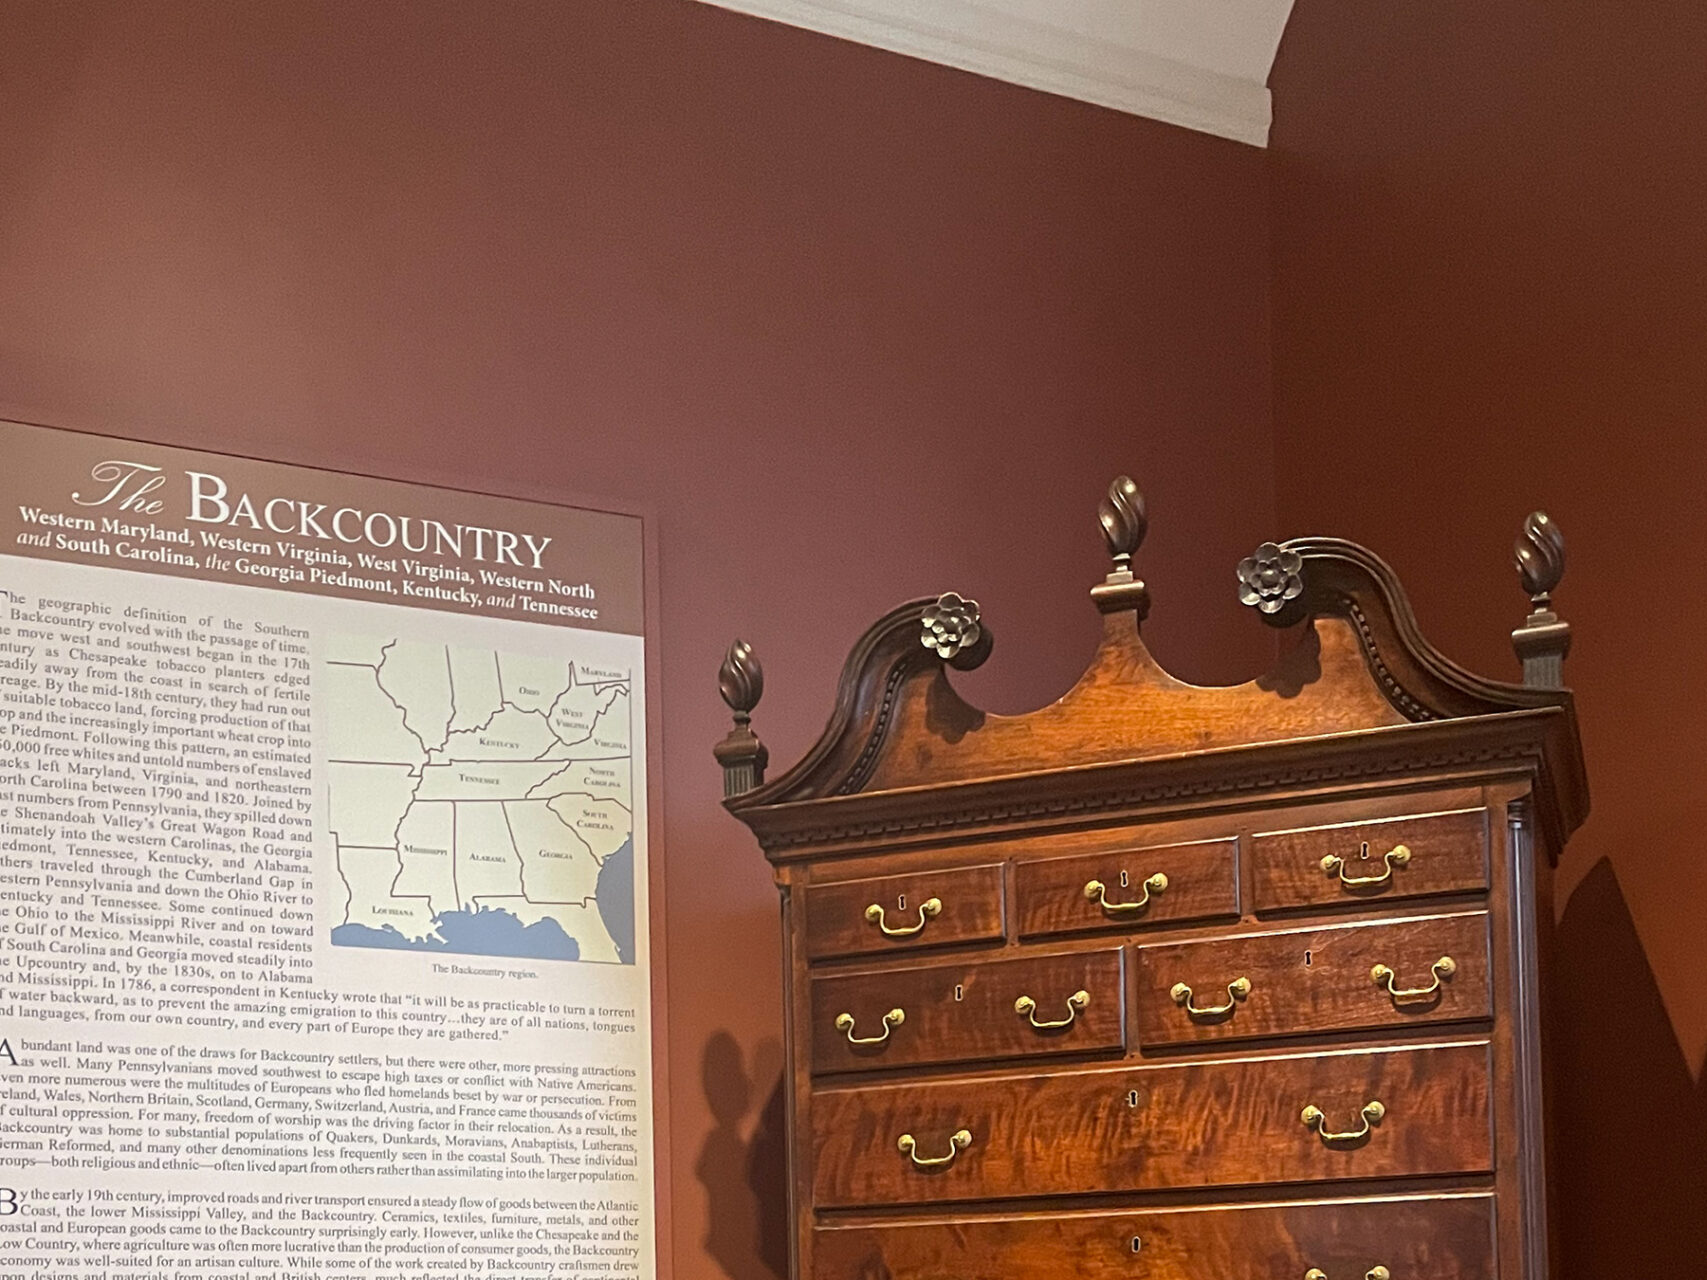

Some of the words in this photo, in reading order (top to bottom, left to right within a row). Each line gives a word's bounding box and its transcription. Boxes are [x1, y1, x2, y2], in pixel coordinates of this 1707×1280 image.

[72, 459, 166, 515] The
[186, 471, 551, 569] BACKCOUNTRY
[19, 505, 95, 530] Western
[100, 517, 194, 546] Maryland,
[200, 530, 270, 555] Western
[277, 541, 352, 568] Virginia,
[357, 552, 397, 572] West
[402, 558, 474, 584] Virginia,
[479, 569, 543, 592] Western
[548, 578, 594, 599] North
[16, 530, 50, 547] and
[55, 533, 110, 555] South
[115, 541, 199, 569] Carolina,
[205, 553, 230, 571] the
[234, 557, 304, 583] Georgia
[310, 567, 397, 595] Piedmont,
[402, 579, 482, 607] Kentucky,
[486, 593, 515, 608] and
[518, 595, 597, 619] Tennessee
[10, 607, 94, 632] Backcountry
[98, 620, 150, 635] evolved
[153, 626, 182, 639] with
[186, 629, 205, 642] the
[209, 634, 258, 650] passage
[261, 638, 276, 651] of
[278, 640, 309, 654] time.
[38, 598, 111, 614] geographic
[123, 605, 186, 624] definition
[198, 615, 213, 627] of
[223, 618, 242, 630] the
[254, 621, 309, 638] Southern
[45, 648, 59, 657] as
[68, 647, 146, 667] Chesapeake
[156, 658, 206, 673] tobacco
[215, 664, 265, 680] planters
[273, 671, 309, 687] edged
[30, 774, 87, 791] Carolina
[91, 779, 145, 796] between
[152, 785, 182, 799] 1790
[186, 790, 209, 802] and
[215, 791, 248, 805] 1820.
[252, 794, 293, 809] Joined
[296, 798, 311, 813] by
[14, 805, 95, 824] Shenandoah
[102, 813, 154, 831] Valley’s
[160, 818, 196, 833] Great
[202, 822, 245, 838] Wagon
[252, 826, 284, 840] Road
[290, 831, 312, 842] and
[14, 921, 47, 935] Gulf
[50, 924, 65, 937] of
[70, 925, 123, 940] Mexico.
[129, 929, 204, 947] Meanwhile,
[208, 936, 252, 948] coastal
[257, 938, 312, 952] residents
[432, 964, 448, 975] The
[451, 965, 506, 979] Backcountry
[508, 969, 539, 980] region.
[18, 971, 97, 990] Mississippi.
[102, 976, 115, 988] In
[121, 977, 155, 992] 1786,
[159, 983, 166, 991] a
[170, 983, 259, 997] correspondent
[263, 985, 275, 997] in
[279, 986, 338, 1004] Kentucky
[342, 993, 376, 1003] wrote
[379, 992, 401, 1004] that
[405, 994, 420, 1005] “it
[424, 995, 446, 1007] will
[450, 995, 464, 1008] be
[467, 1000, 479, 1009] as
[482, 999, 545, 1012] practicable
[548, 1003, 559, 1013] to
[563, 1004, 585, 1015] turn
[588, 1007, 594, 1015] a
[598, 1007, 634, 1017] torrent
[18, 1004, 89, 1022] languages,
[94, 1008, 125, 1021] from
[129, 1013, 151, 1023] our
[155, 1014, 182, 1024] own
[186, 1016, 238, 1030] country,
[242, 1016, 264, 1029] and
[268, 1020, 302, 1033] every
[306, 1022, 330, 1034] part
[334, 1021, 349, 1032] of
[351, 1021, 394, 1037] Europe
[397, 1024, 423, 1039] they
[426, 1028, 444, 1037] are
[448, 1027, 508, 1041] gathered.”
[21, 1057, 35, 1068] as
[39, 1056, 70, 1068] well.
[76, 1057, 112, 1073] Many
[118, 1059, 212, 1075] Pennsylvanians
[217, 1064, 257, 1076] moved
[262, 1065, 320, 1078] southwest
[325, 1069, 337, 1079] to
[341, 1071, 380, 1084] escape
[384, 1069, 409, 1085] high
[414, 1073, 443, 1084] taxes
[447, 1076, 459, 1084] or
[463, 1074, 504, 1086] conflict
[508, 1076, 532, 1087] with
[537, 1077, 573, 1089] Native
[576, 1079, 635, 1092] Americans.
[20, 1203, 60, 1218] Coast,
[65, 1204, 85, 1216] the
[90, 1204, 126, 1217] lower
[131, 1206, 200, 1221] Mississippi
[205, 1206, 246, 1222] Valley,
[251, 1208, 272, 1219] and
[278, 1208, 296, 1220] the
[301, 1208, 376, 1224] Backcountry.
[381, 1210, 438, 1224] Ceramics,
[443, 1211, 486, 1224] textiles,
[491, 1212, 541, 1225] furniture,
[546, 1213, 584, 1226] metals,
[588, 1214, 607, 1225] and
[611, 1214, 639, 1226] other
